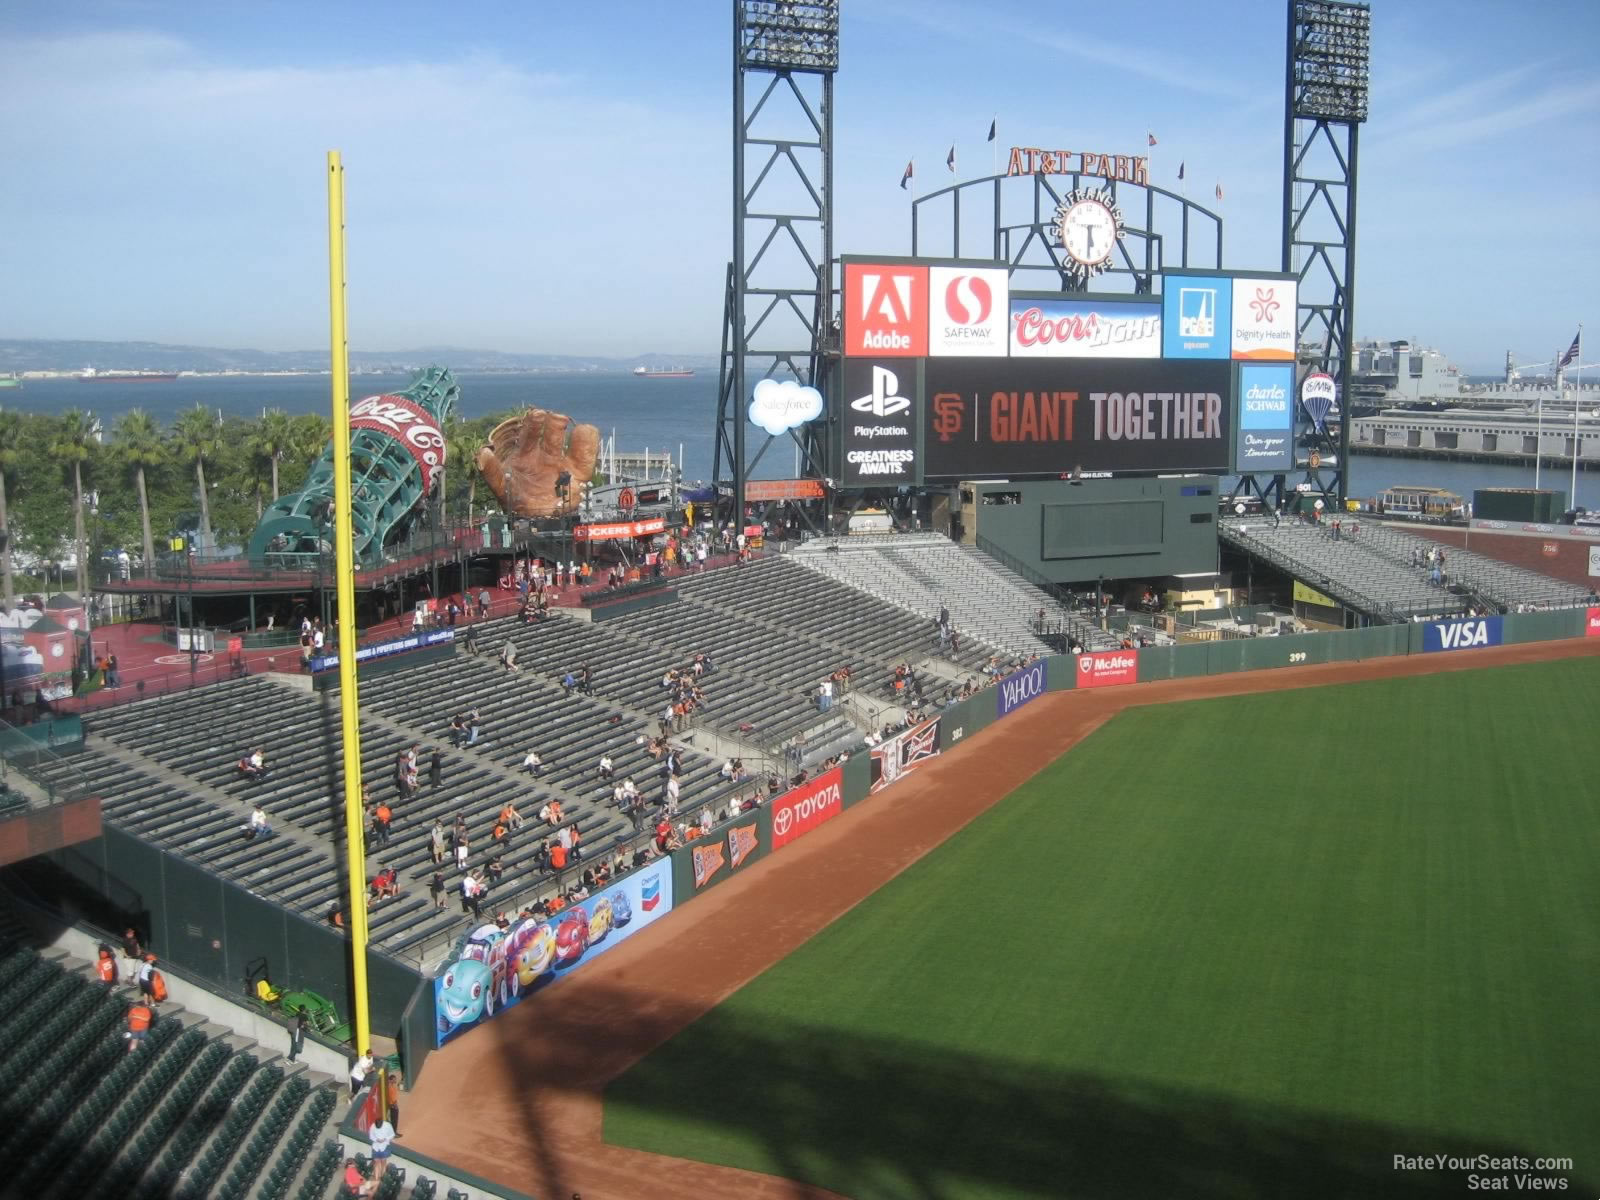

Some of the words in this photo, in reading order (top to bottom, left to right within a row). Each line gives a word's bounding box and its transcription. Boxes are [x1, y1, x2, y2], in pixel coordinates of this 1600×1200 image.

[1008, 147, 1071, 177] AT&T
[1081, 152, 1149, 187] PARK
[1051, 202, 1068, 237] SAN
[1067, 187, 1126, 239] FRANCISCO
[1062, 255, 1115, 277] GIANTS
[944, 327, 992, 338] SAFEWAY
[1014, 307, 1098, 347] Coors
[1089, 316, 1160, 348] LIGHT
[1236, 329, 1264, 341] Dignity
[1265, 330, 1292, 340] Health
[863, 329, 910, 349] Adobe
[1246, 384, 1286, 399] charles
[761, 397, 812, 416] salesforce
[1246, 400, 1286, 412] SCHWAB
[990, 391, 1078, 442] GIANT
[1089, 392, 1222, 441] TOGETHER
[847, 450, 914, 463] GREATNESS
[1435, 620, 1489, 649] VISA
[1094, 656, 1135, 670] McAfee
[1289, 651, 1306, 663] 399
[1002, 663, 1043, 713] YAHOO!
[793, 783, 841, 822] TOYOTA
[641, 873, 660, 887] Chevron
